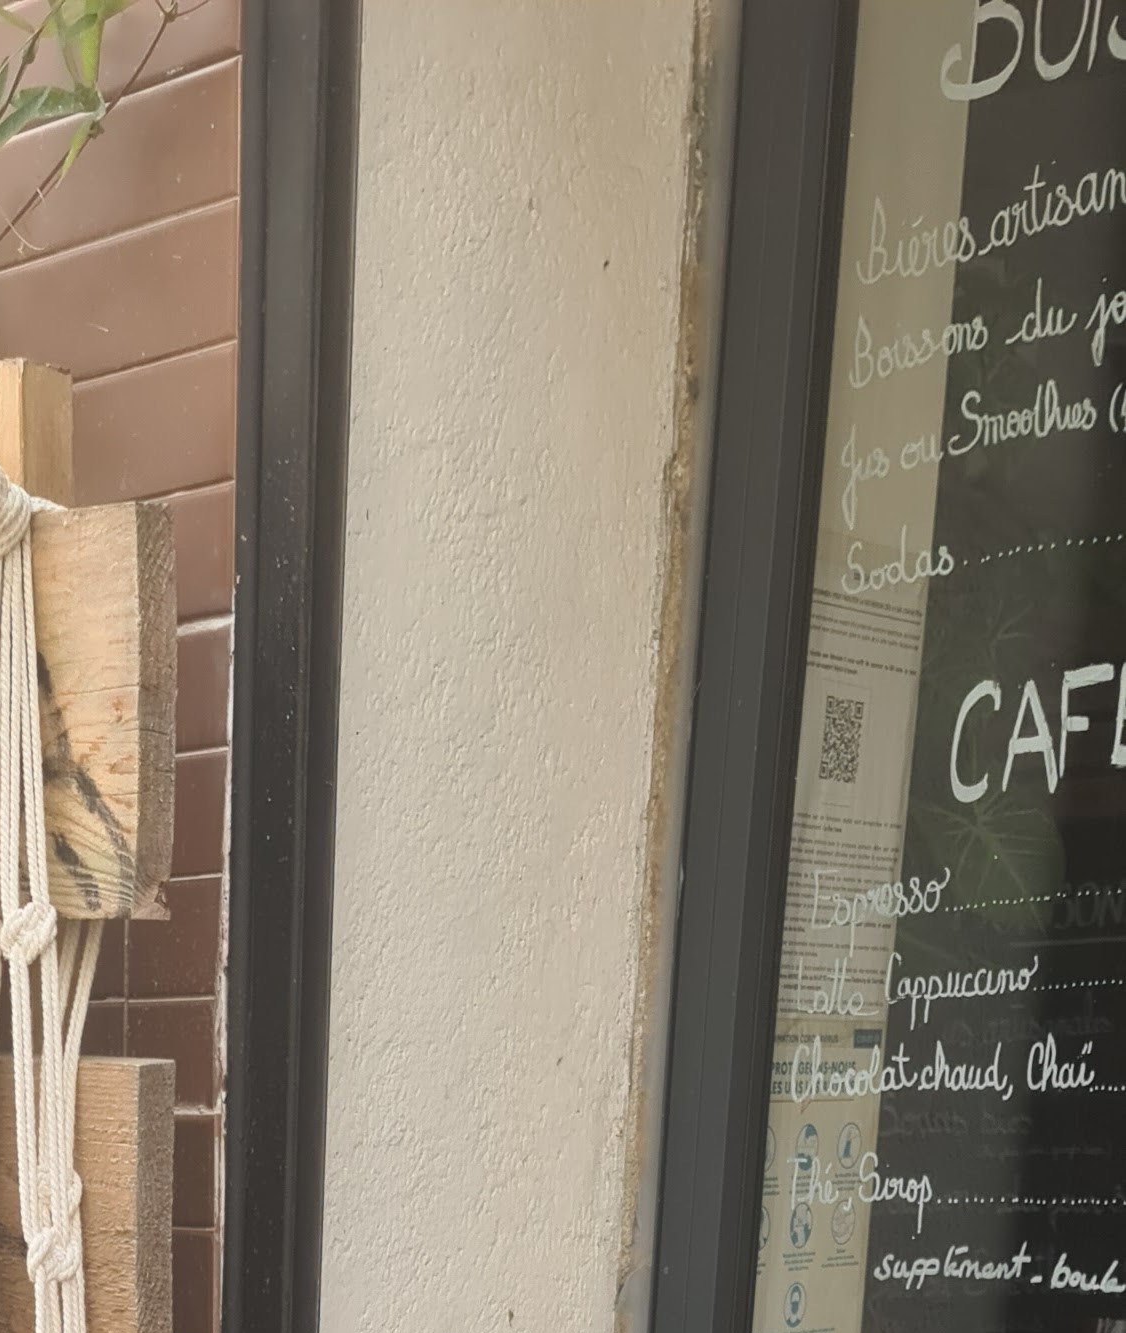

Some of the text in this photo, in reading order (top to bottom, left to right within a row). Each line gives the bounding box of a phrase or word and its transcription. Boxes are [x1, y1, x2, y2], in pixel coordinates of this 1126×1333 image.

[849, 313, 989, 388] Boissons
[1005, 277, 1077, 345] du
[841, 423, 890, 531] Jus
[900, 433, 944, 470] ou
[810, 866, 951, 957] Espresso
[791, 1035, 918, 1104] Chocolat
[858, 1151, 933, 1234] Sirop
